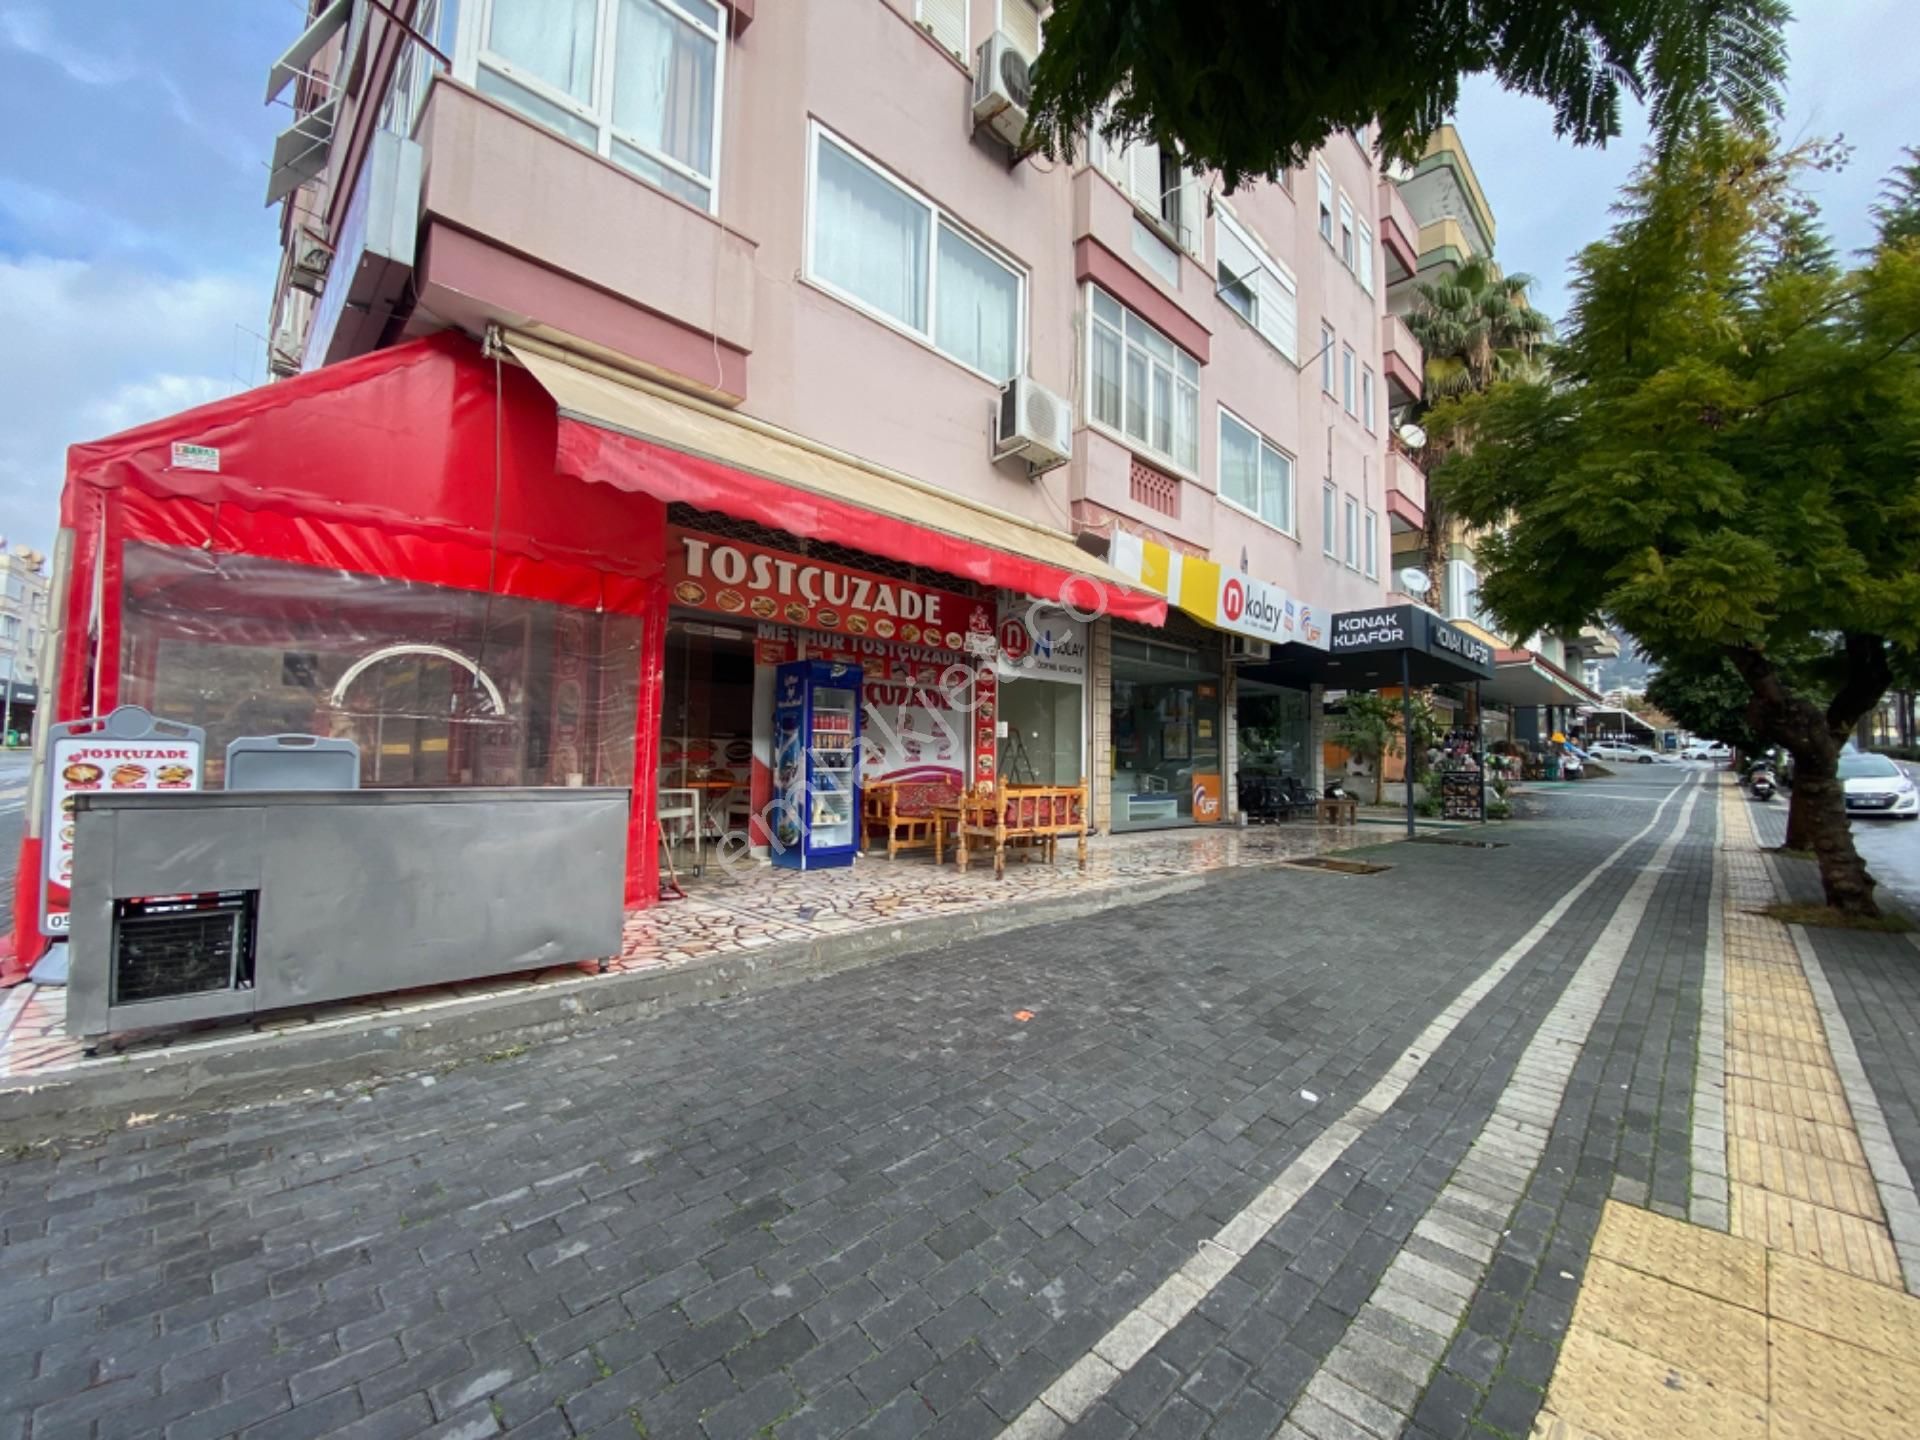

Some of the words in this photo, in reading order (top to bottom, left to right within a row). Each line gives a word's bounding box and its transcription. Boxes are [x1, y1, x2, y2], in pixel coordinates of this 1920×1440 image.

[681, 536, 943, 626] TOSTÇUZADE
[1245, 583, 1282, 633] kolay
[1338, 613, 1397, 632] KONAK
[1333, 628, 1404, 647] KUAFÖR
[80, 748, 189, 760] TOSTÇUZADE
